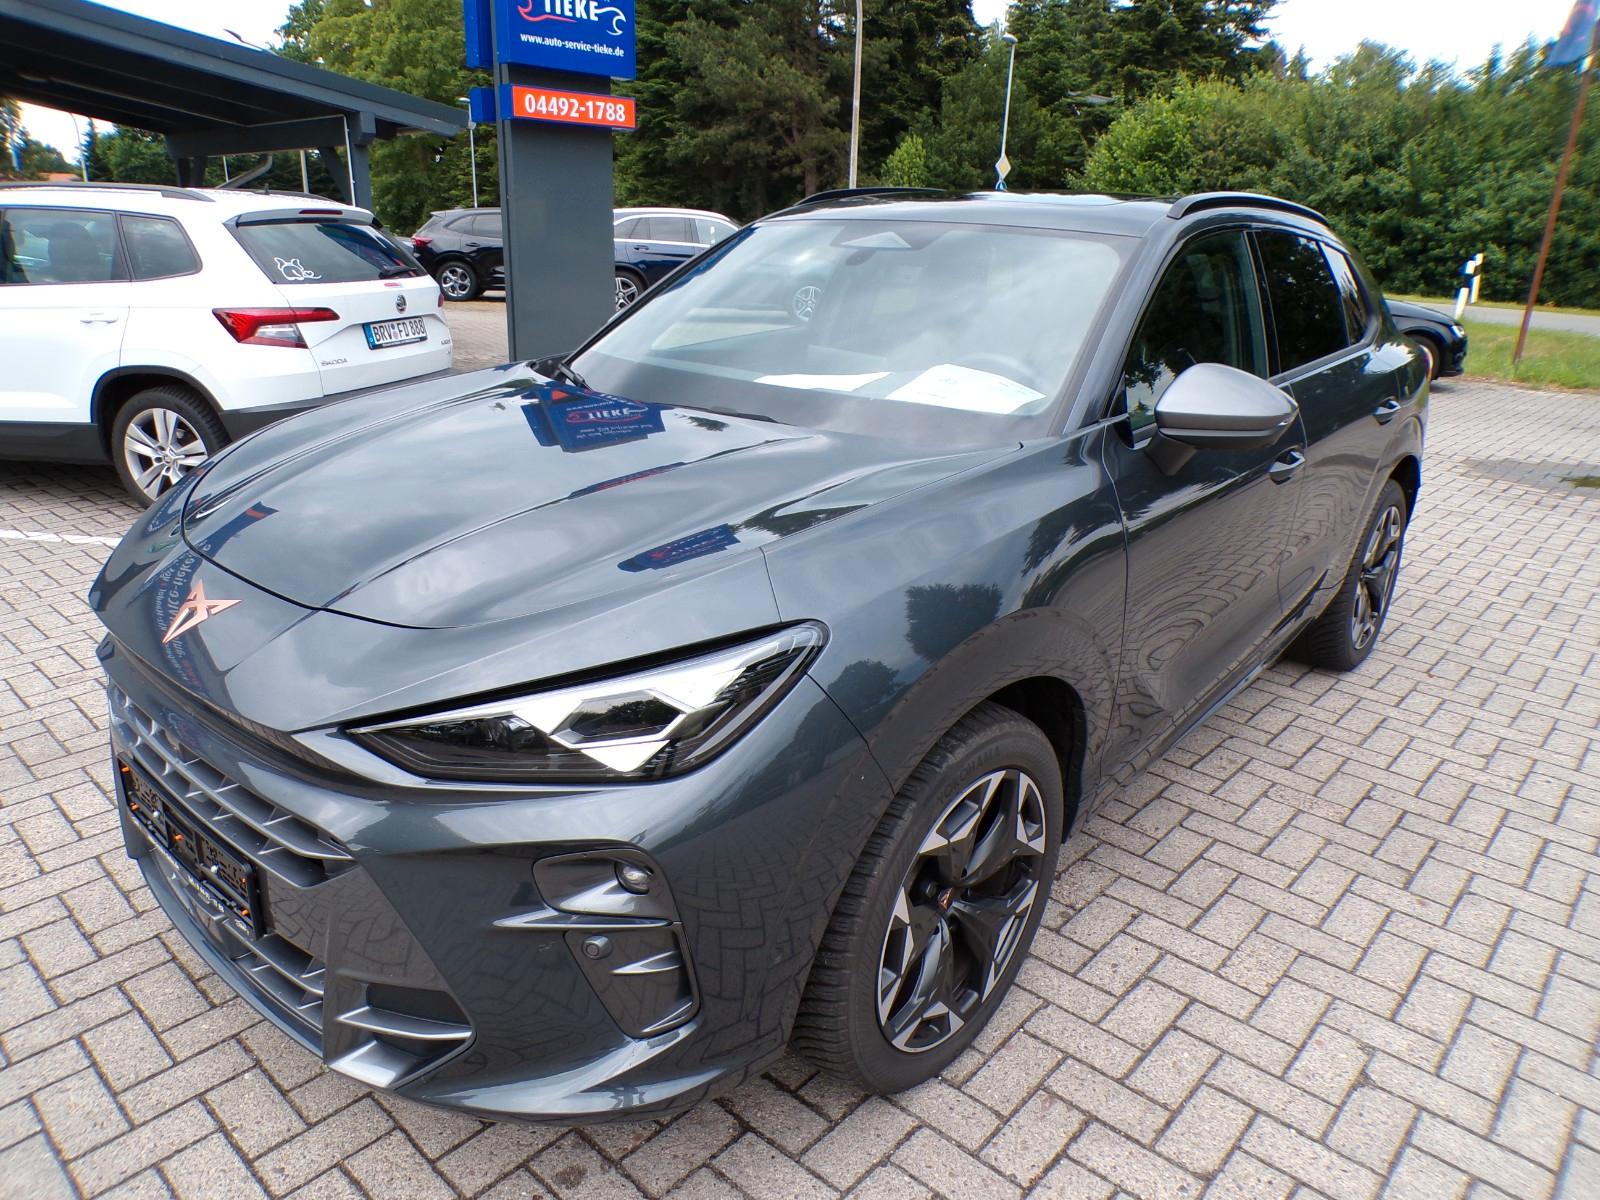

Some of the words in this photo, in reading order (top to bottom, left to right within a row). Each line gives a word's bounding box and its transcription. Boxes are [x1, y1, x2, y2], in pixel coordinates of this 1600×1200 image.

[544, 0, 599, 22] TIEKE
[520, 33, 625, 57] www.auto-service-tieke.de
[524, 93, 627, 122] 04492-1788
[373, 323, 392, 342] BRV
[398, 322, 410, 338] FD
[410, 319, 425, 336] 888
